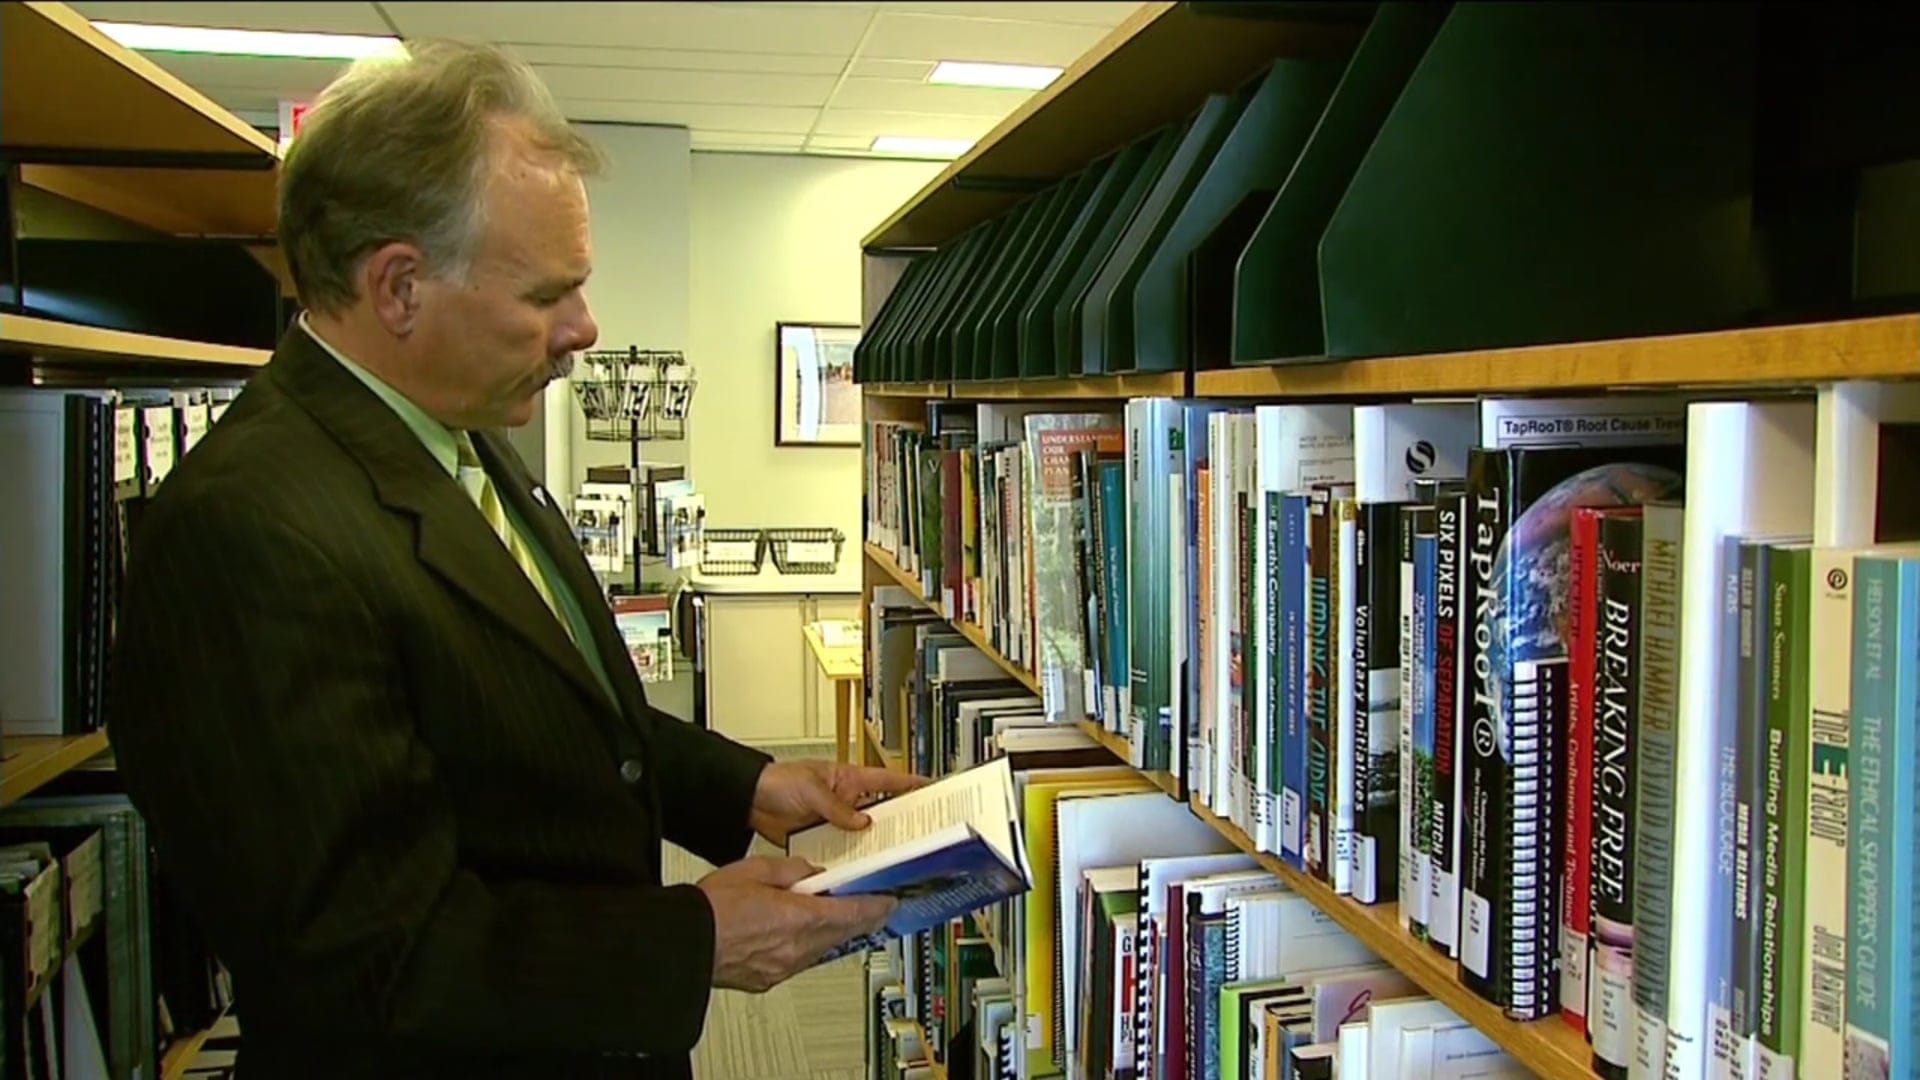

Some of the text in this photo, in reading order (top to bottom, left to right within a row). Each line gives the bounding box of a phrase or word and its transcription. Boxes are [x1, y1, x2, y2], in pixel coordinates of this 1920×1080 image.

[1577, 418, 1609, 433] Root
[1610, 417, 1651, 432] Cause
[1268, 519, 1279, 575] Earth's
[1356, 530, 1366, 566] Gibson
[1267, 577, 1278, 655] Company
[1436, 511, 1456, 776] SIX PIXELS OF SEPARATION
[1642, 540, 1677, 731] MICHAEL HAMMER
[1771, 582, 1787, 700] Susan Sommers
[1354, 605, 1368, 813] Voluntary Initiatives
[1568, 678, 1580, 733] Artists,
[1812, 707, 1850, 744] The
[1862, 715, 1882, 753] THE
[1566, 738, 1579, 820] Craftsmen
[1597, 598, 1629, 904] BREAKING FREE
[1430, 801, 1446, 856] MITCH
[1859, 757, 1880, 835] ETHICAL
[1566, 823, 1577, 853] and
[1734, 803, 1749, 921] MEDIA RELATIONS
[1761, 728, 1783, 1036] Building Media Relationships
[1812, 925, 1846, 962] Joel
[1855, 945, 1877, 1011] GUIDE
